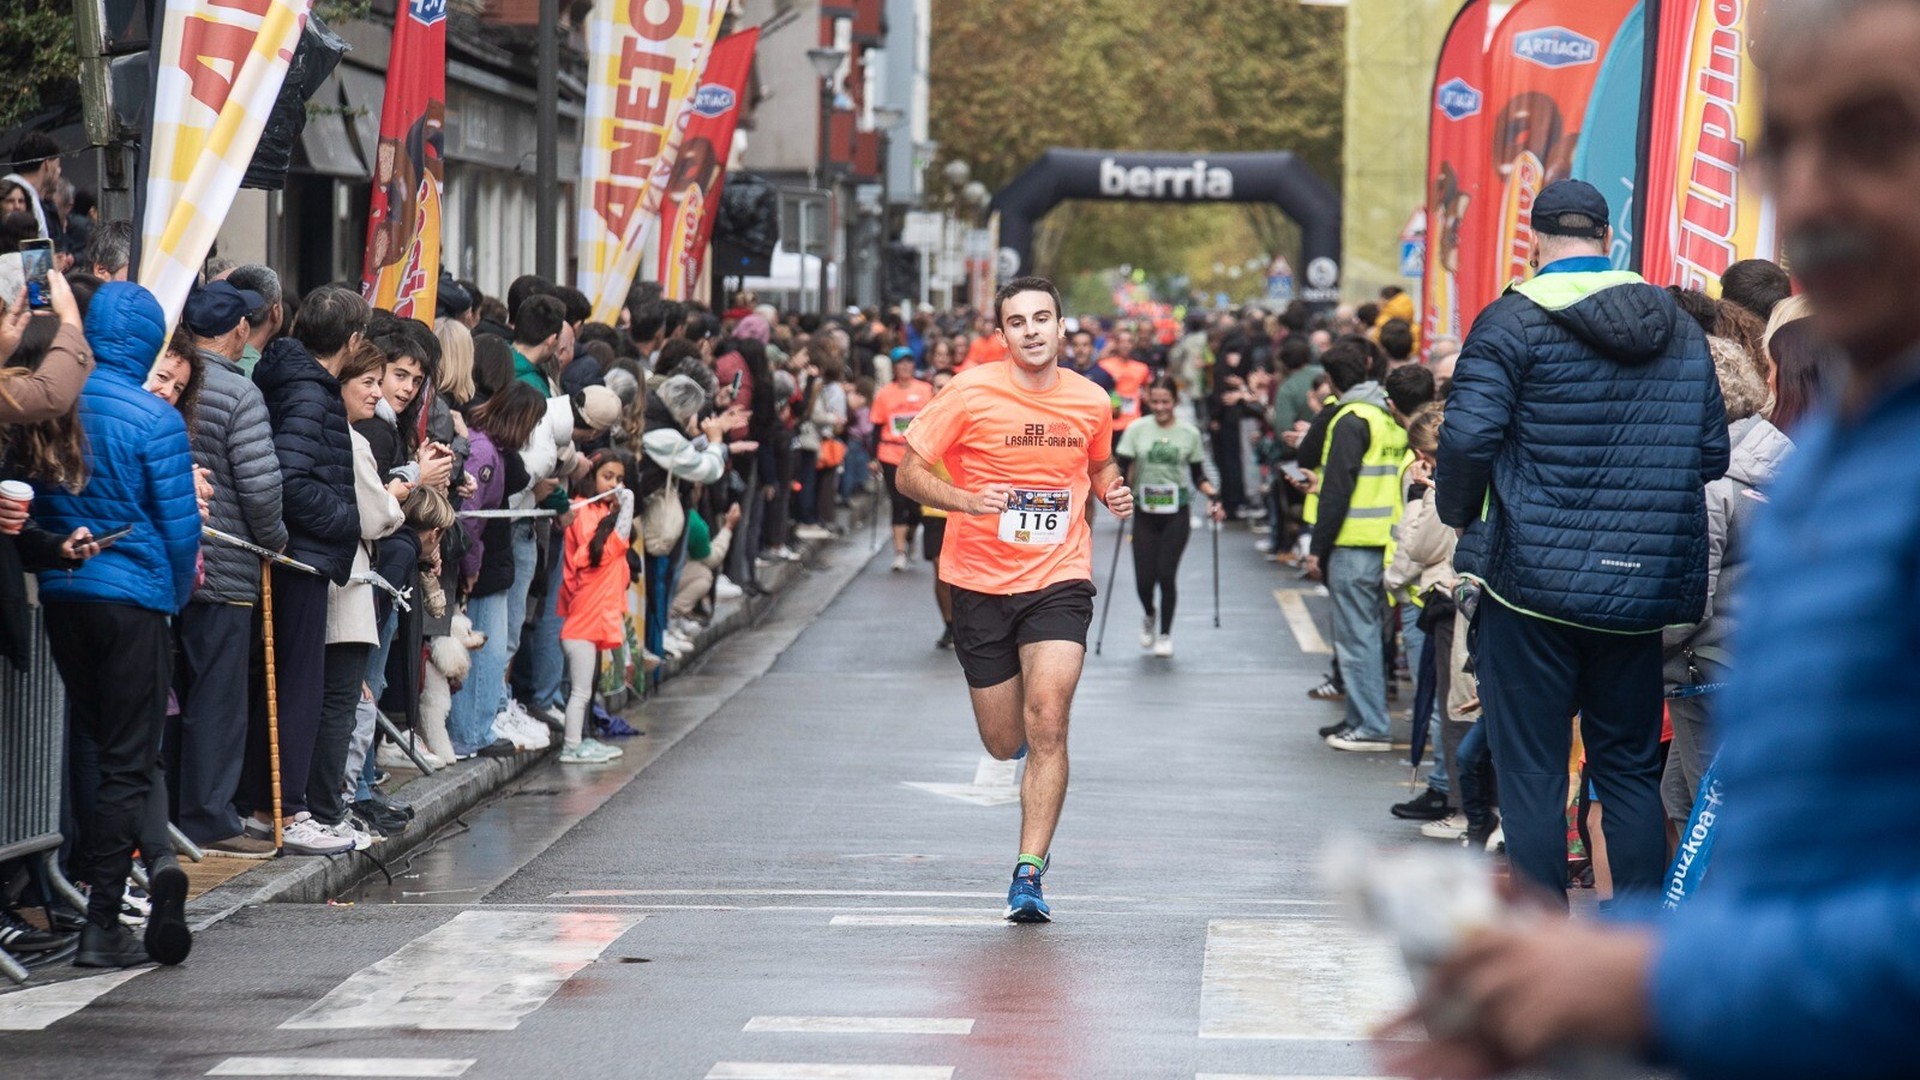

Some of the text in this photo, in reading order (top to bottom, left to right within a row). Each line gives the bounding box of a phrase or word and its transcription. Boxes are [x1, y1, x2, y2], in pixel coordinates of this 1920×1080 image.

[1517, 35, 1592, 60] ARTIACH
[1100, 158, 1233, 198] berria
[1005, 435, 1066, 447] LASARTE-ORIA
[1019, 512, 1058, 530] 116
